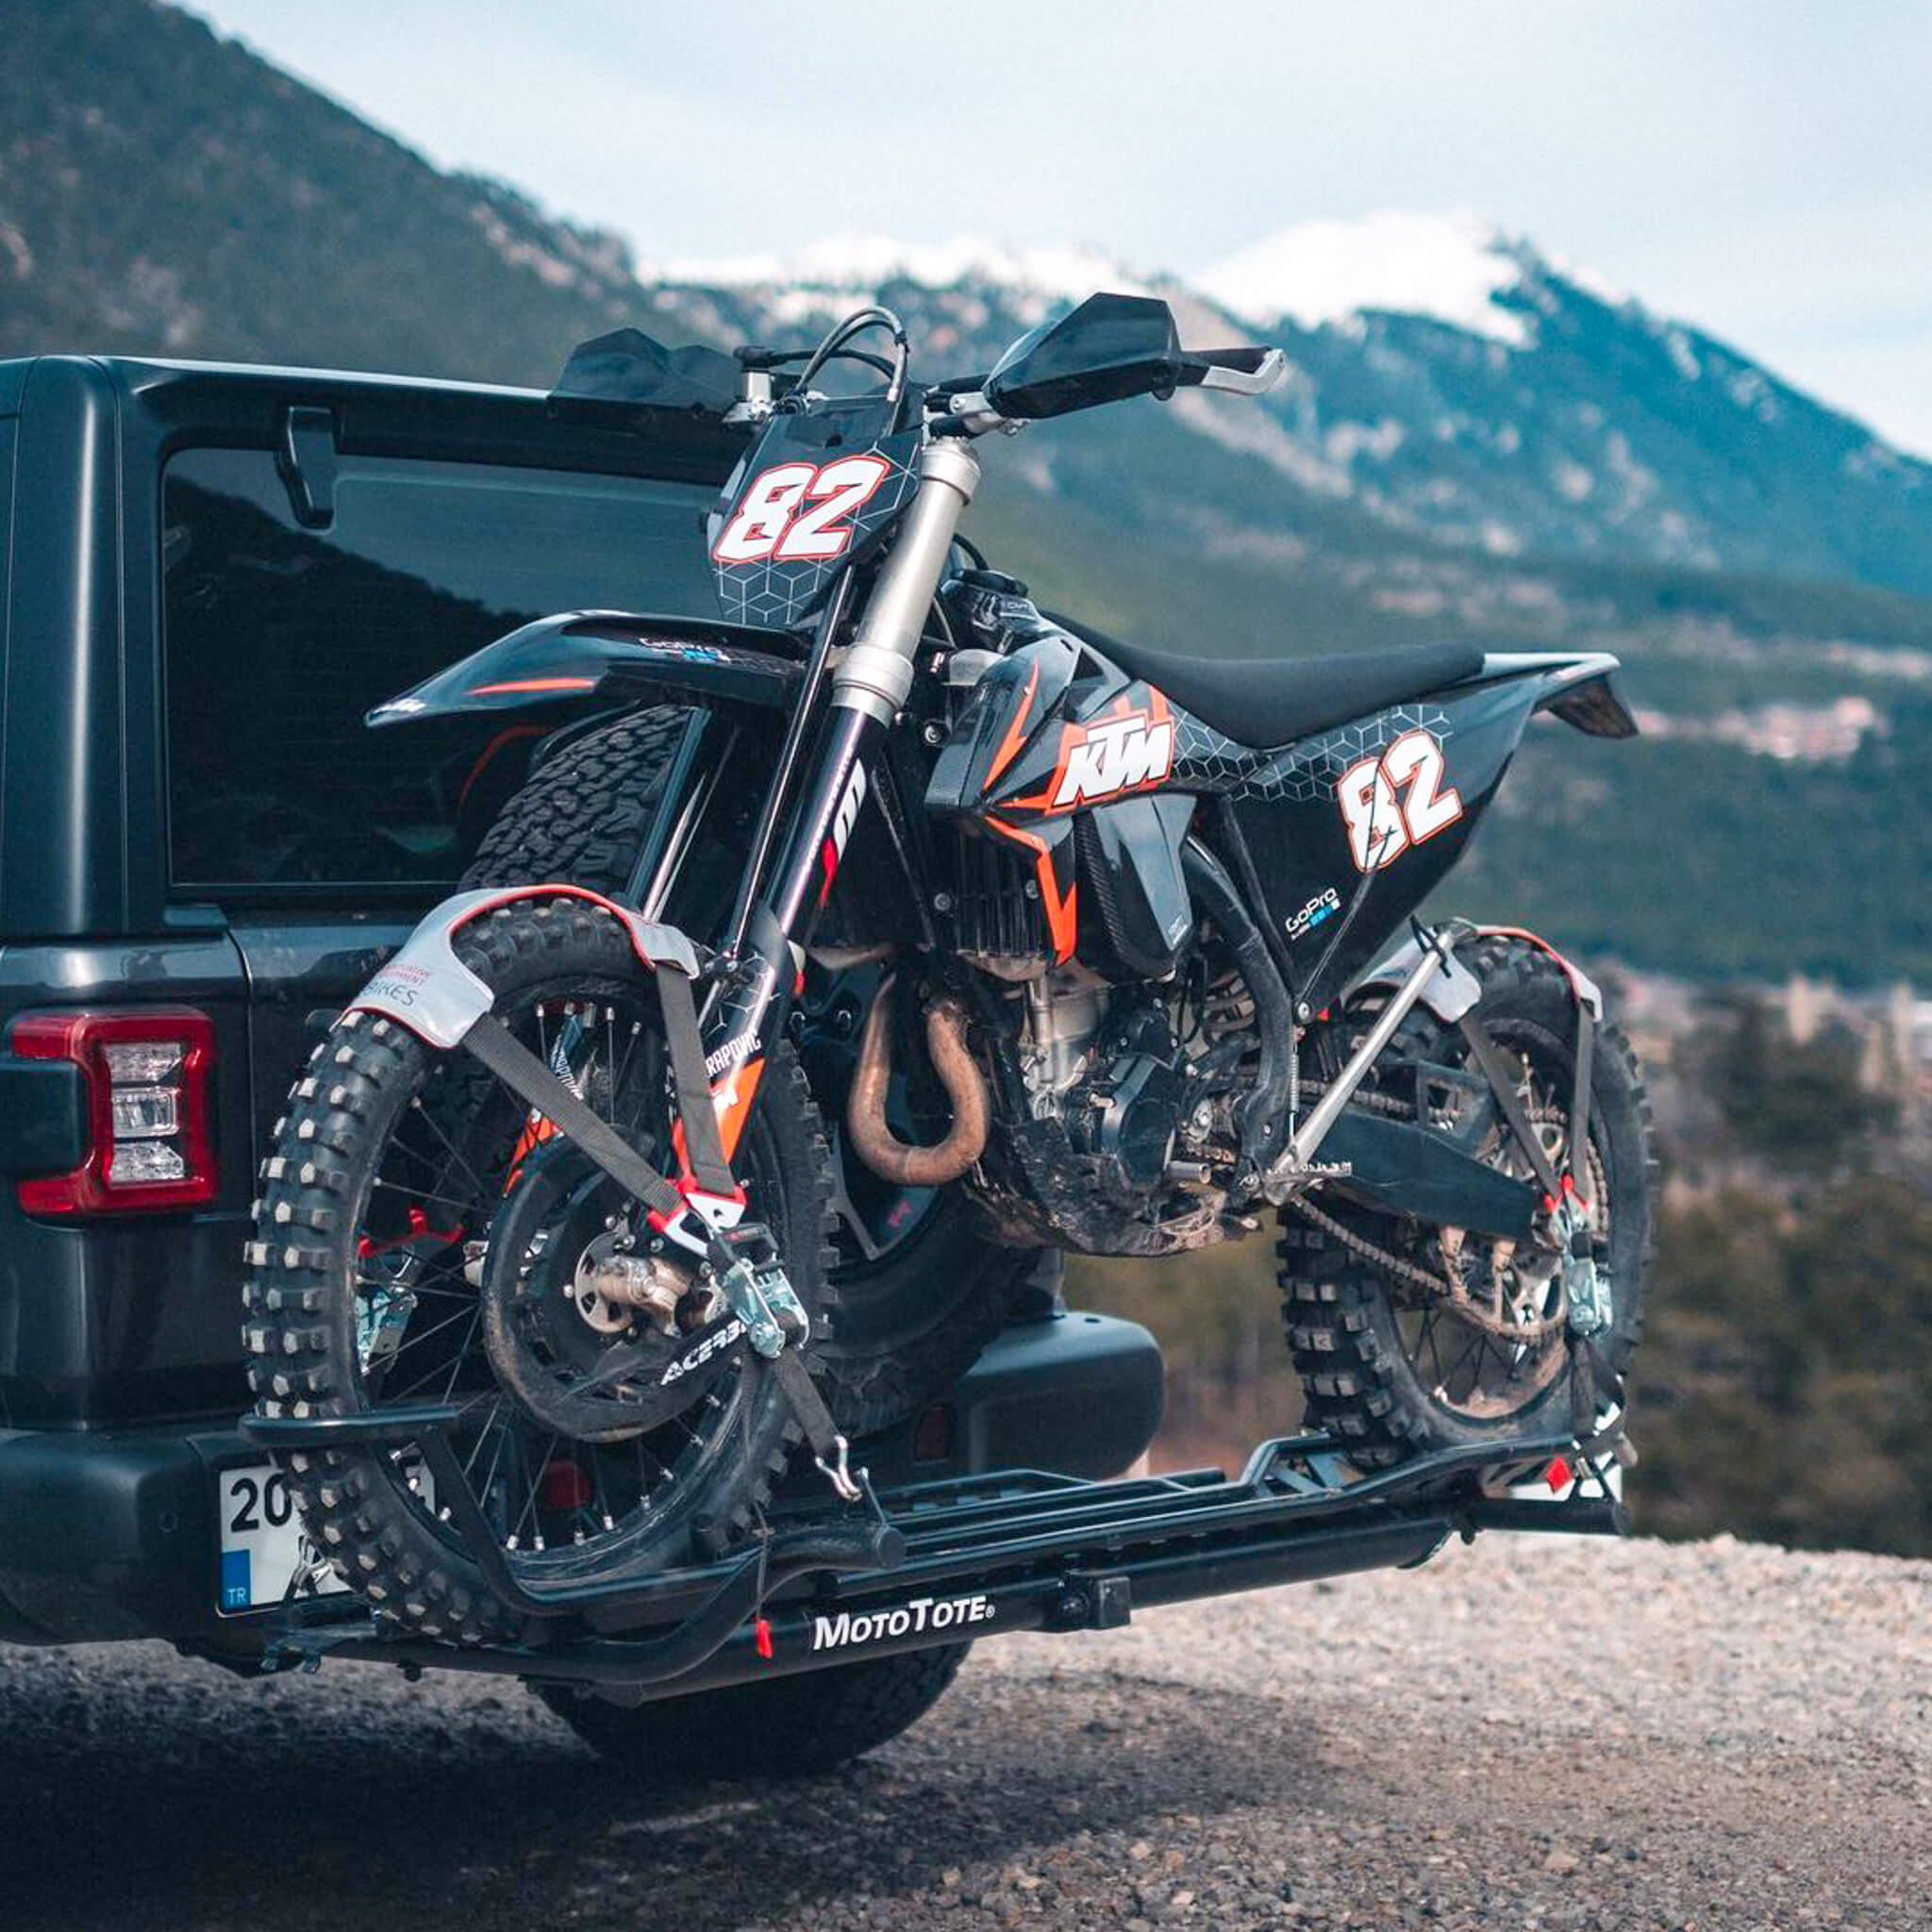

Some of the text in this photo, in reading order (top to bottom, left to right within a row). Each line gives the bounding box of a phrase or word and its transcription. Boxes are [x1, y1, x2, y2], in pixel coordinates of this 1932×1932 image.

[712, 455, 891, 564] 82
[1053, 716, 1171, 807] KTM
[1338, 729, 1463, 874] 82
[1285, 887, 1338, 932] GoPro
[660, 1319, 747, 1385] ACERB
[230, 1473, 292, 1533] 20
[227, 1587, 247, 1605] TR
